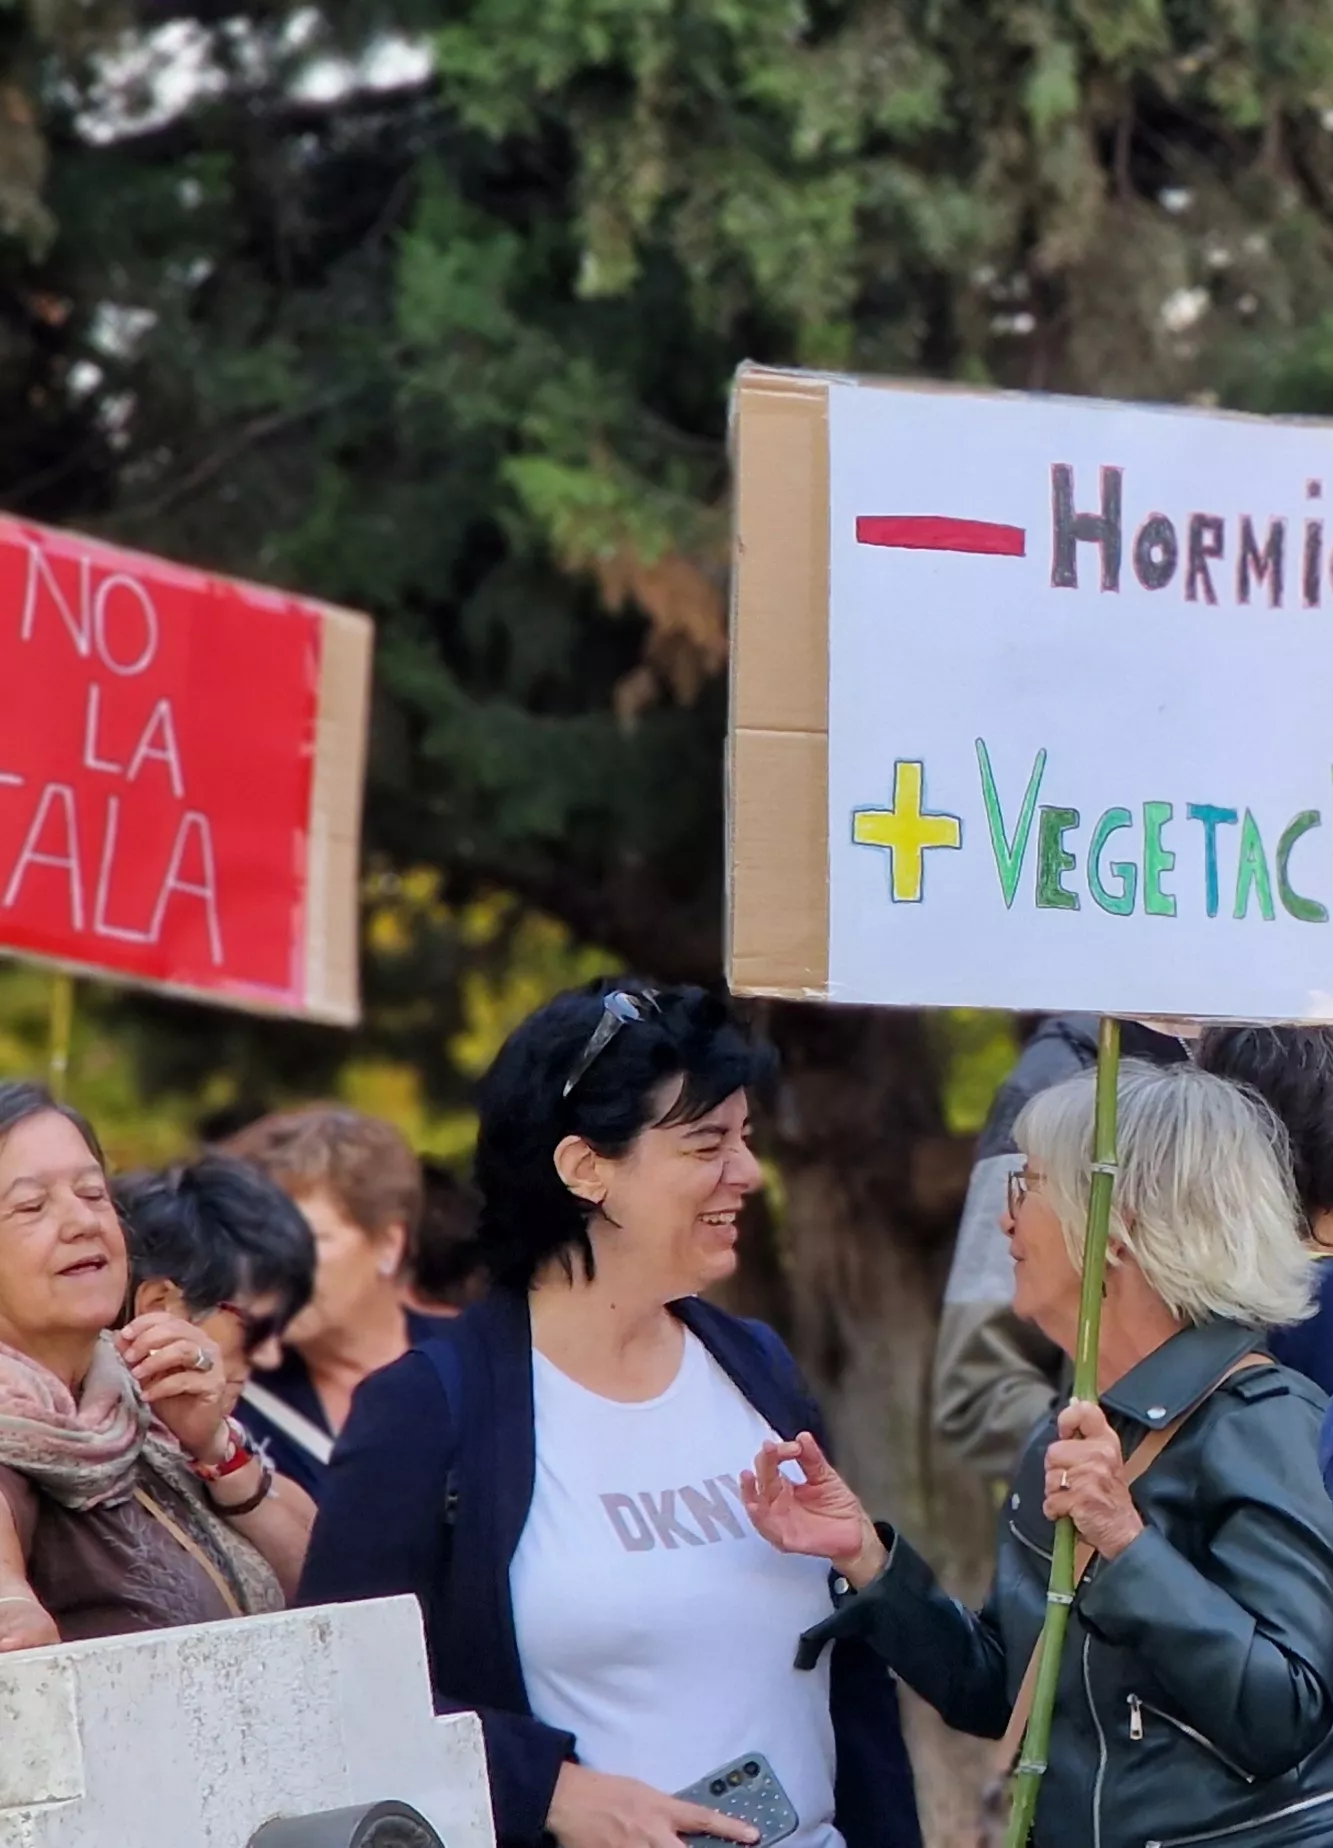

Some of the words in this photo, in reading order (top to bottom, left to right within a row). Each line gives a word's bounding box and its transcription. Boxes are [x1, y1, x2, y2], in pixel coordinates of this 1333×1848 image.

[21, 538, 159, 677] NO
[84, 681, 185, 799] LA
[0, 773, 225, 967] ALA
